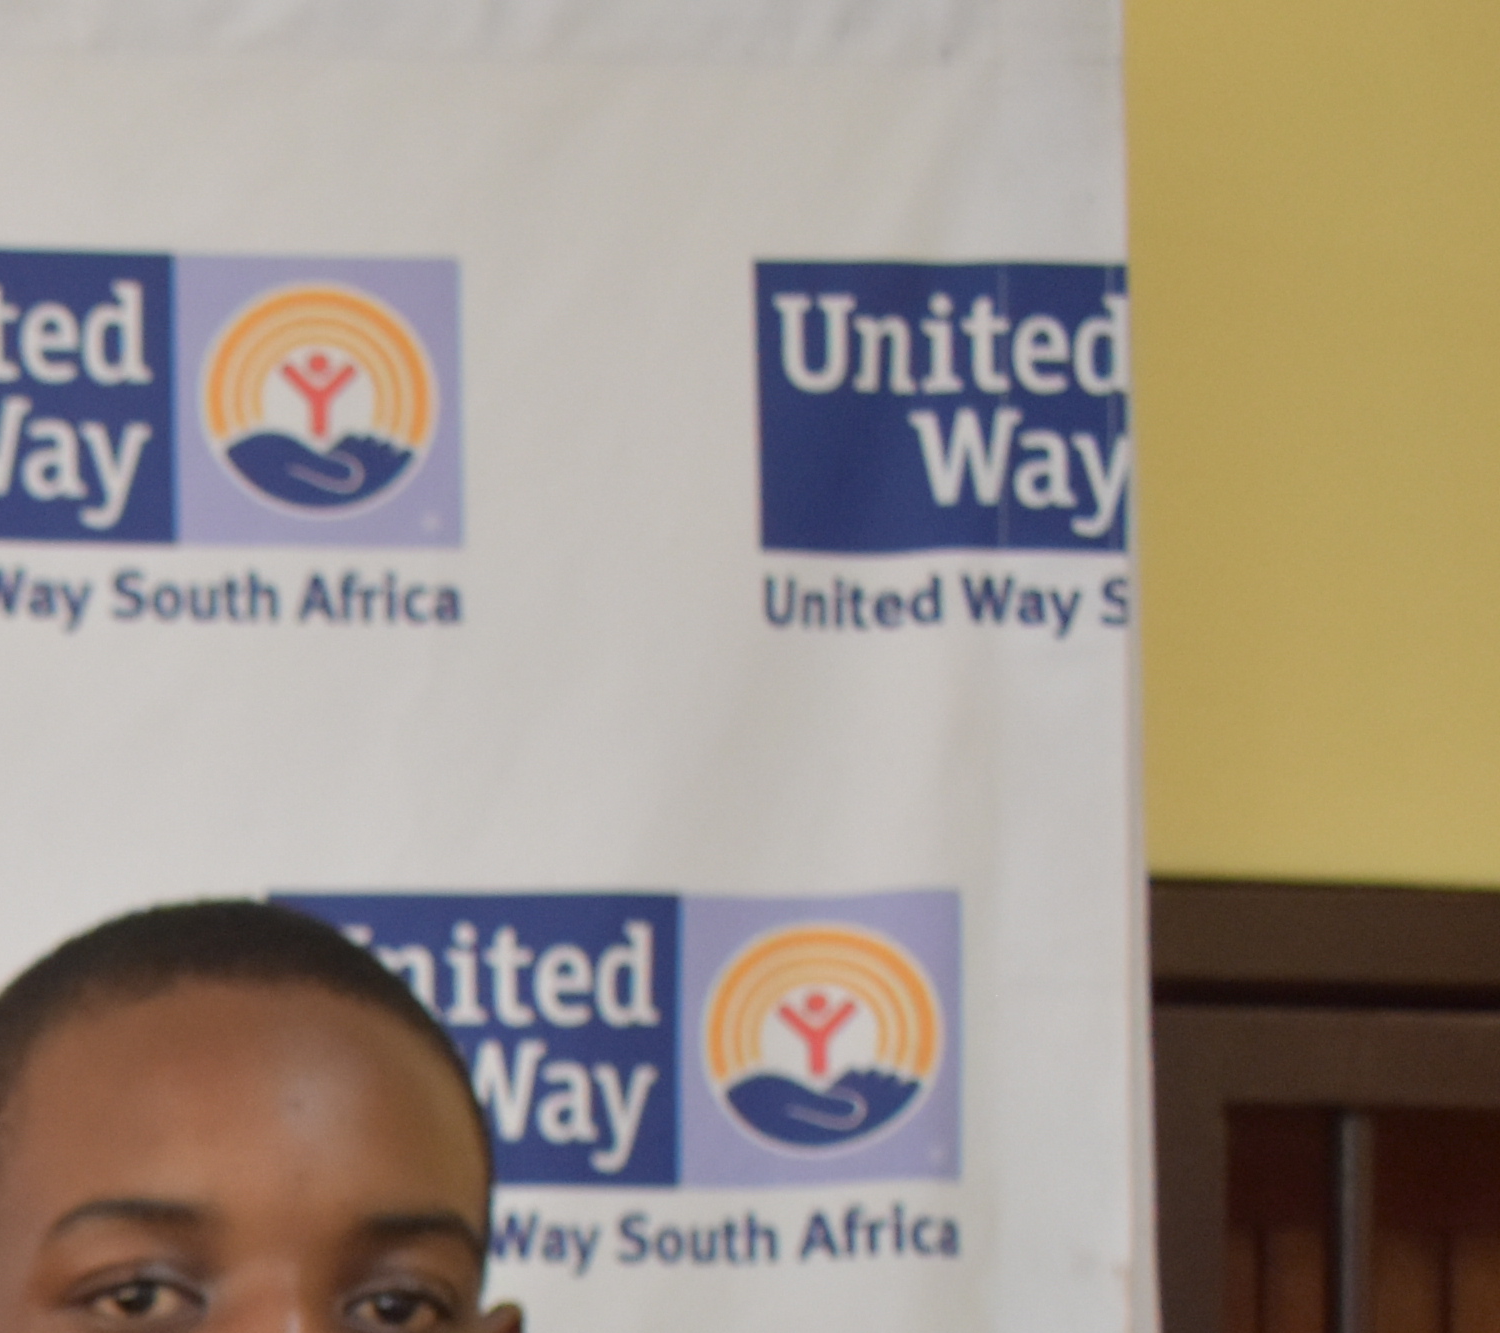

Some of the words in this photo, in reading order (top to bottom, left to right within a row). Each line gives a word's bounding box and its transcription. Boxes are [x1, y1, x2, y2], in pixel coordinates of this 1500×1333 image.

[771, 292, 1127, 396] United
[907, 407, 1128, 537] Way
[111, 568, 279, 622] South
[298, 570, 462, 626] Africa
[762, 574, 943, 629] United
[960, 572, 1081, 640] Way
[342, 919, 661, 1028] nited
[618, 1214, 777, 1268] South
[800, 1205, 960, 1262] Africa
